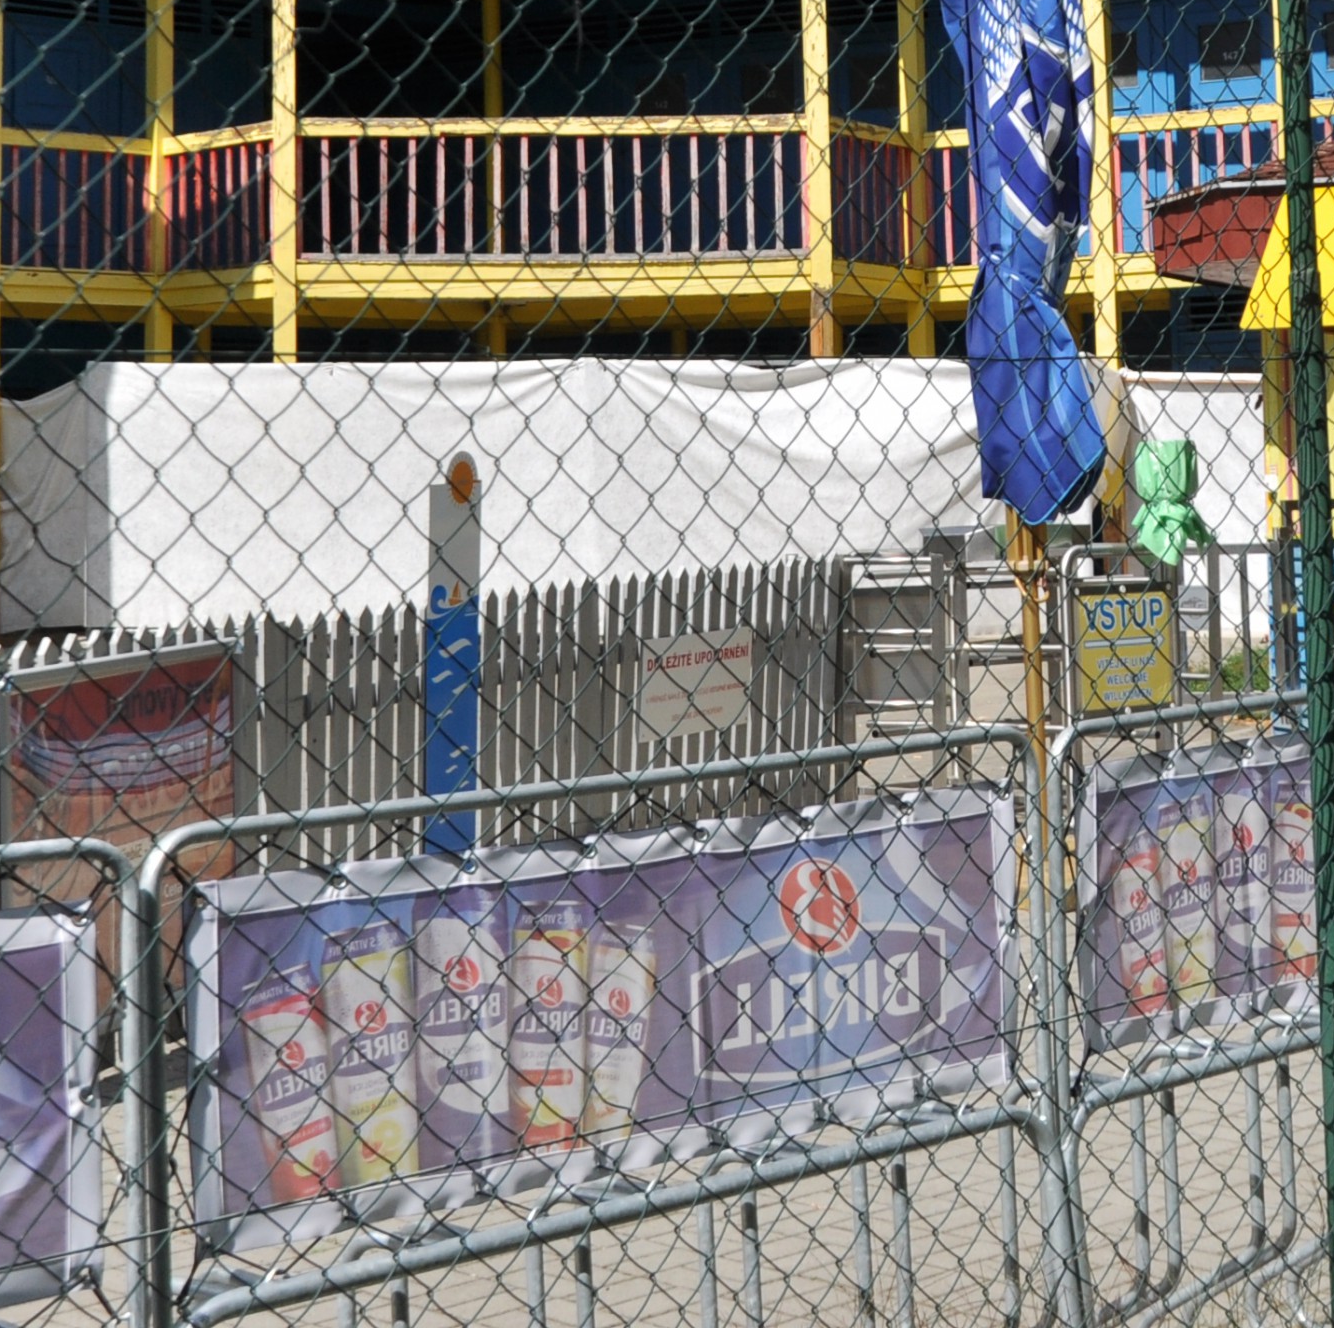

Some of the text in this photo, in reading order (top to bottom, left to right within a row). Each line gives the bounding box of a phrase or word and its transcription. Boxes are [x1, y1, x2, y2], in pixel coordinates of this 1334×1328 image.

[1084, 598, 1163, 631] VSTUP
[647, 642, 749, 672] DLEŽITÉ UPOORNĚNÍ
[1107, 672, 1148, 685] WELCME
